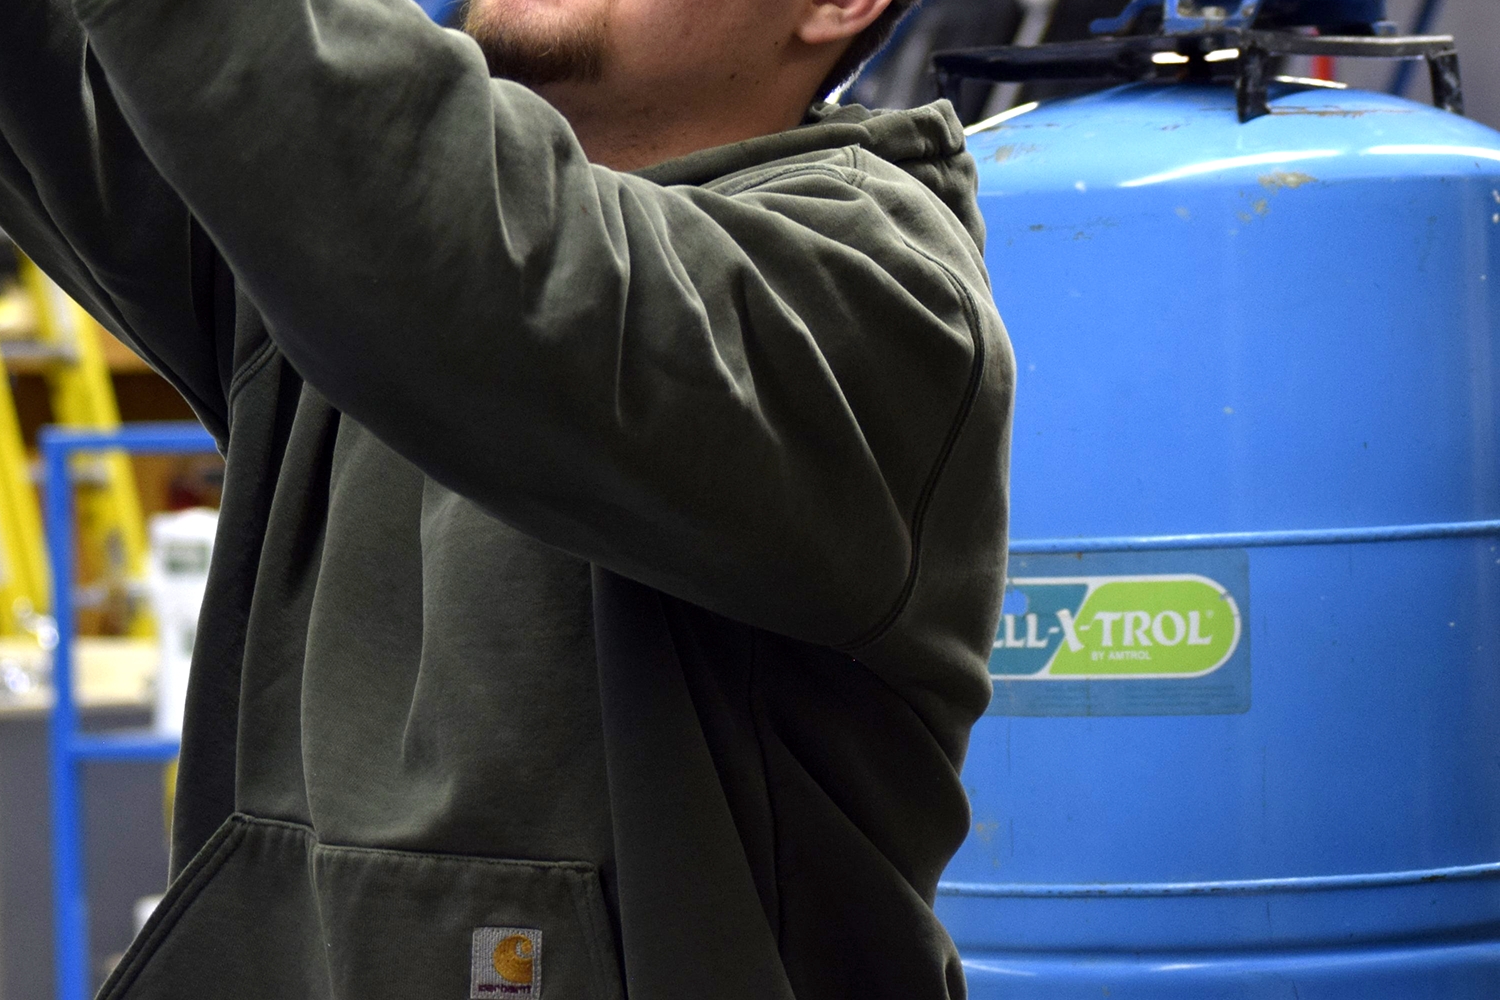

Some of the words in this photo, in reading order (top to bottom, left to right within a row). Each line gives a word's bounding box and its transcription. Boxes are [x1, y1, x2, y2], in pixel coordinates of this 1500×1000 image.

[993, 608, 1214, 652] LL-X-TROL
[1090, 652, 1105, 661] BY
[1108, 651, 1152, 661] AMTROL
